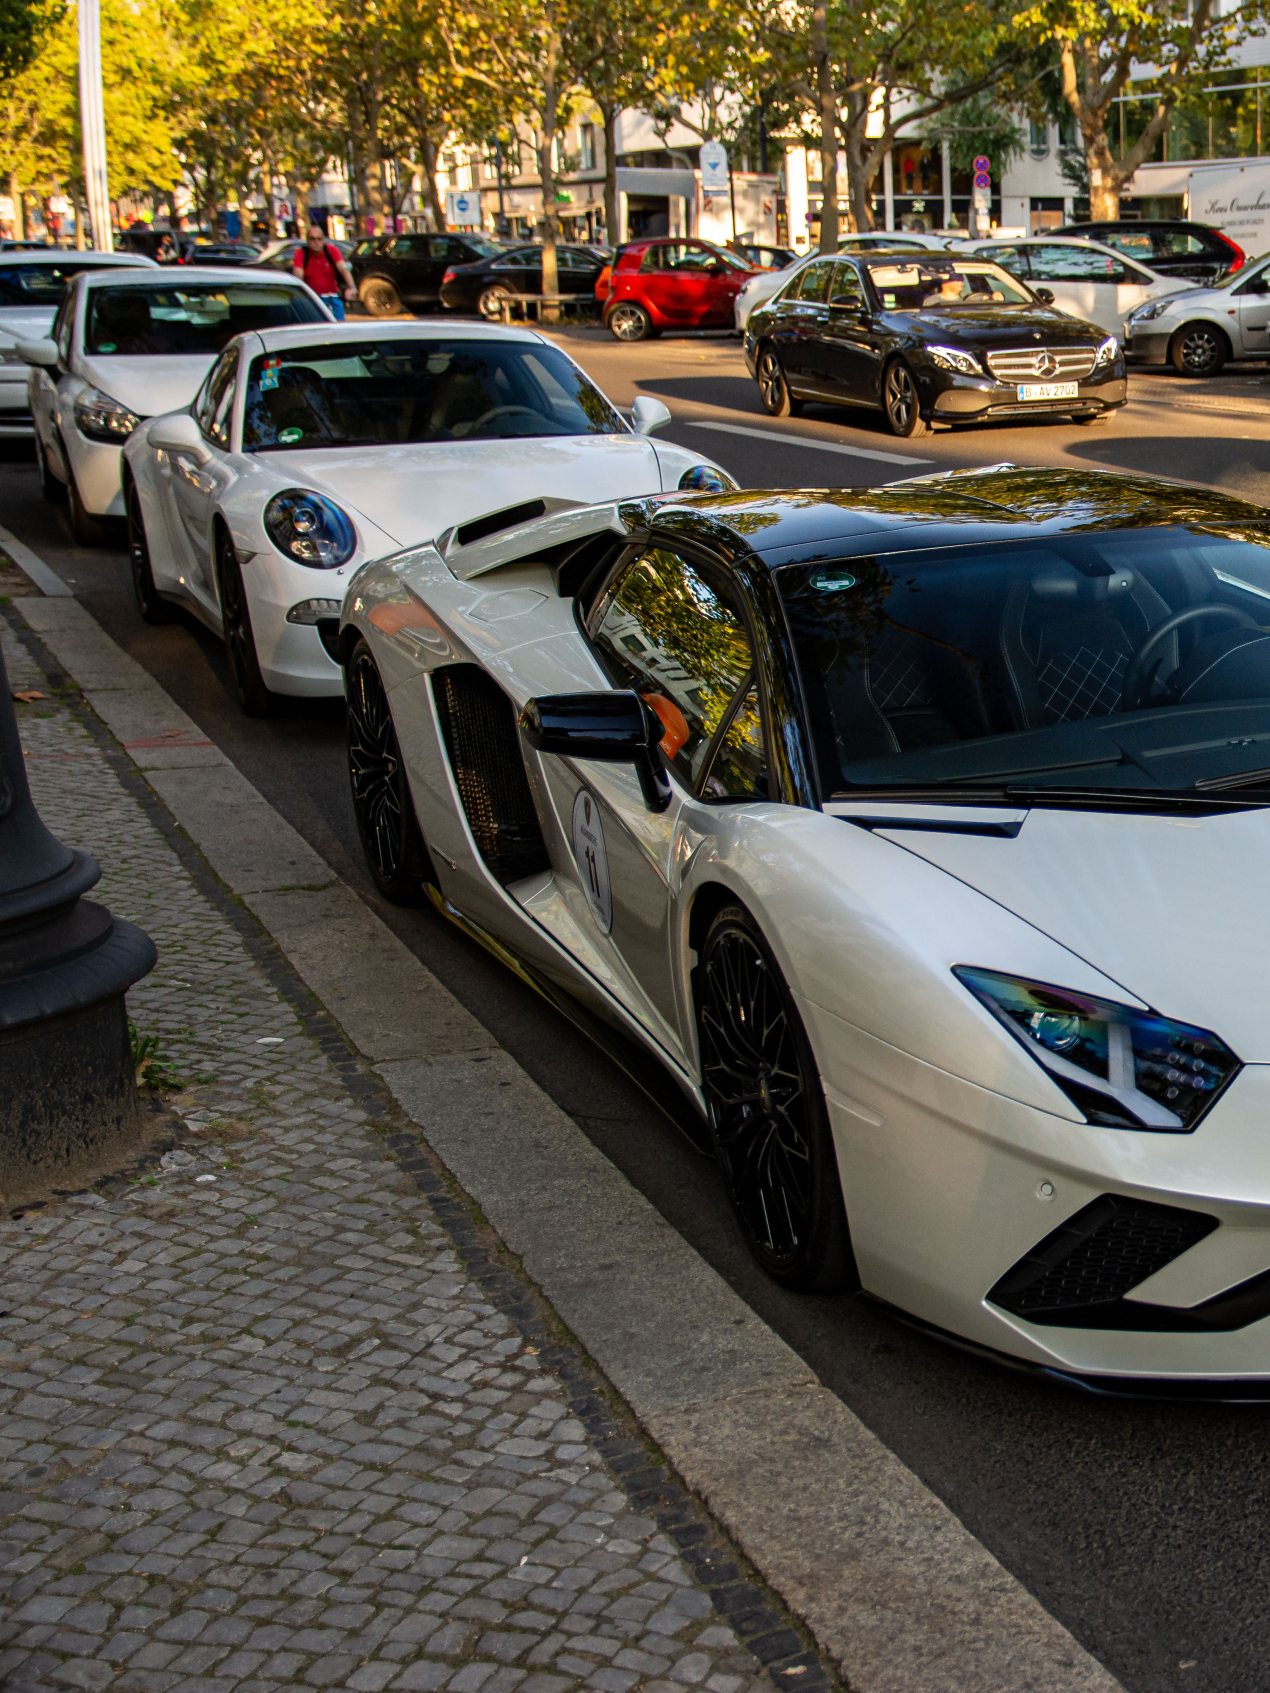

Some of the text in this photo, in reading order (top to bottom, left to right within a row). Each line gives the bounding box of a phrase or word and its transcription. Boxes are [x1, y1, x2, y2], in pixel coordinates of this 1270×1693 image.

[1025, 384, 1076, 398] B AV 2702
